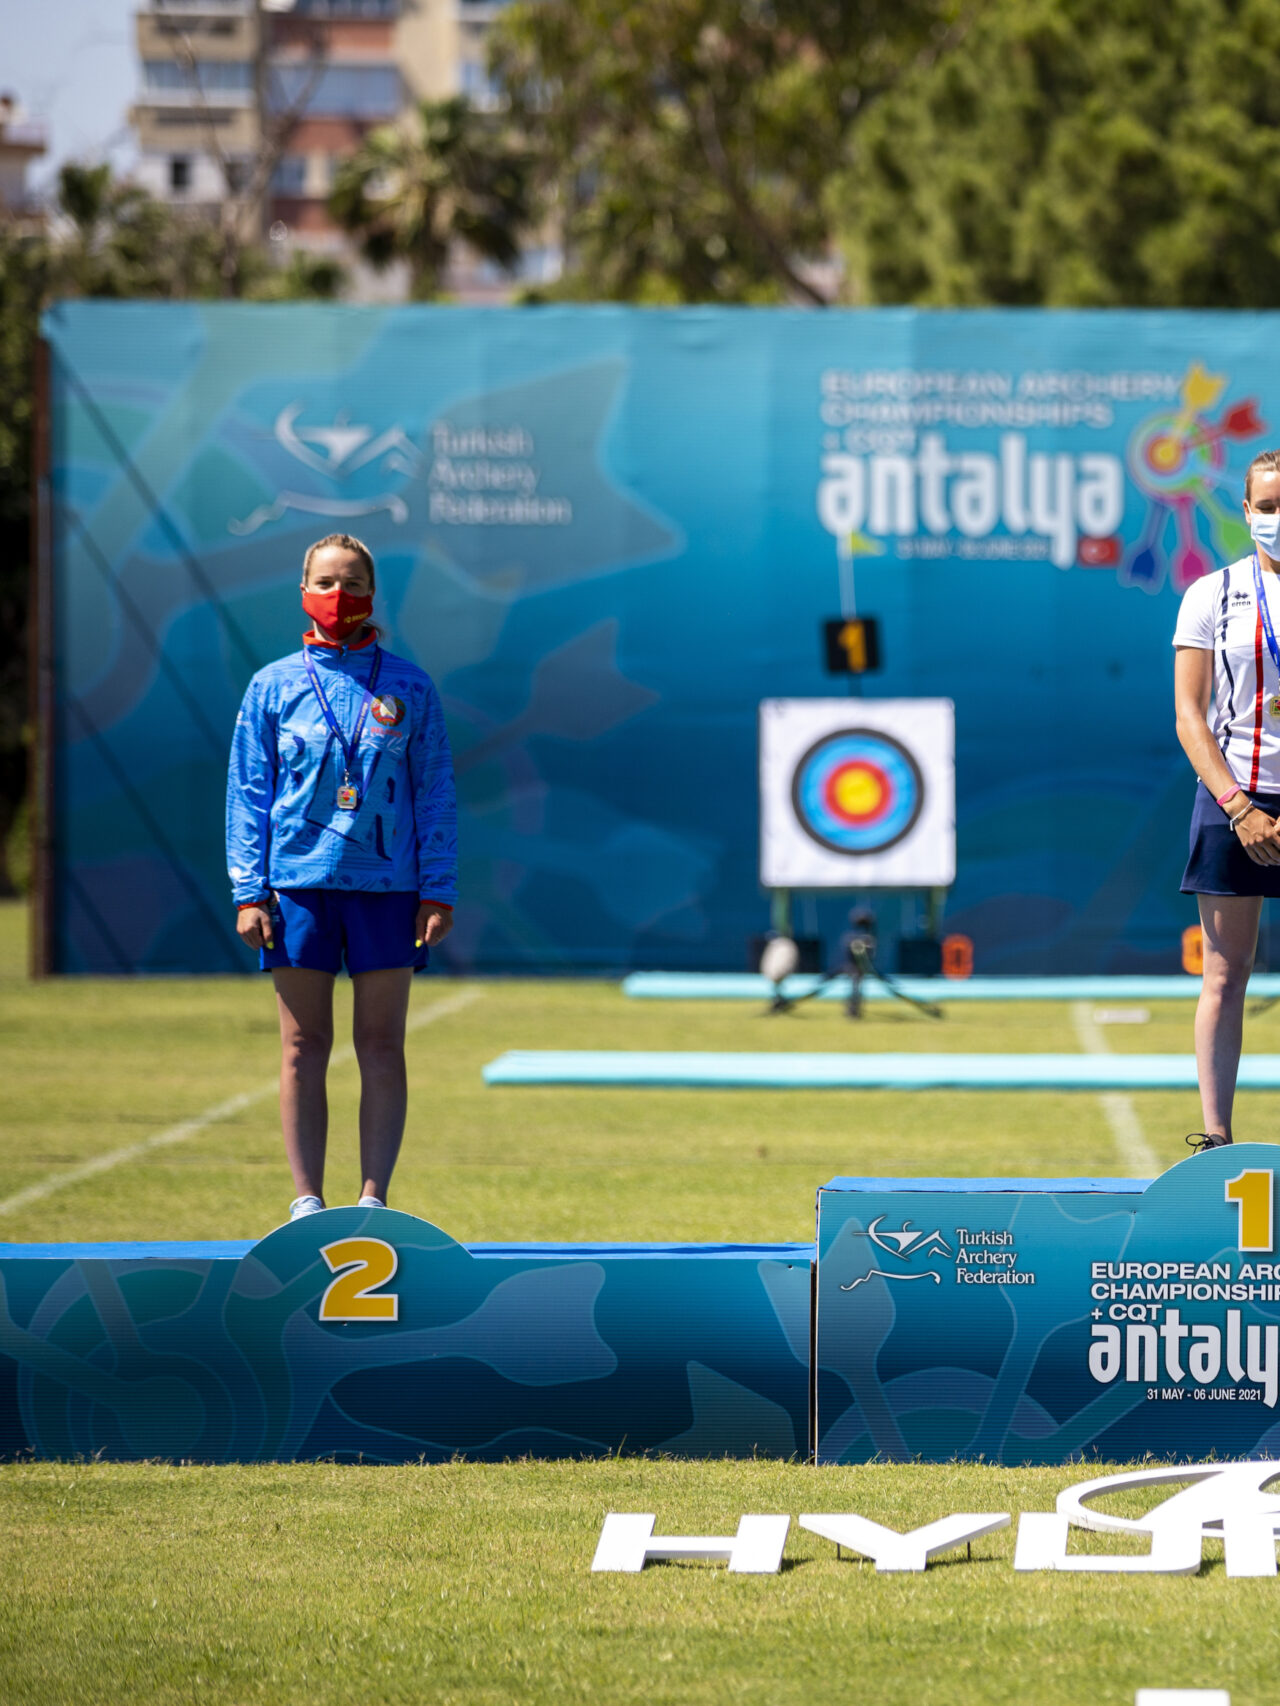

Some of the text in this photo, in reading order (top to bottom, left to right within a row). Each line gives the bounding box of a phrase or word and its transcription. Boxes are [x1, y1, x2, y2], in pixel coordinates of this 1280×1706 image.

[817, 432, 1125, 569] antalya
[837, 619, 867, 674] 1
[1225, 1169, 1273, 1252] 1
[956, 1229, 1013, 1245] Turkish
[955, 1248, 1017, 1268] Archery
[319, 1237, 398, 1321] 2
[956, 1267, 1035, 1284] Federation
[1091, 1262, 1231, 1280] EUROPEAN
[1108, 1304, 1162, 1322] CQT
[1147, 1388, 1158, 1400] 31
[1161, 1388, 1185, 1400] MAY
[1193, 1388, 1206, 1400] 06
[1208, 1388, 1237, 1400] JUNE
[1238, 1388, 1261, 1400] 2021
